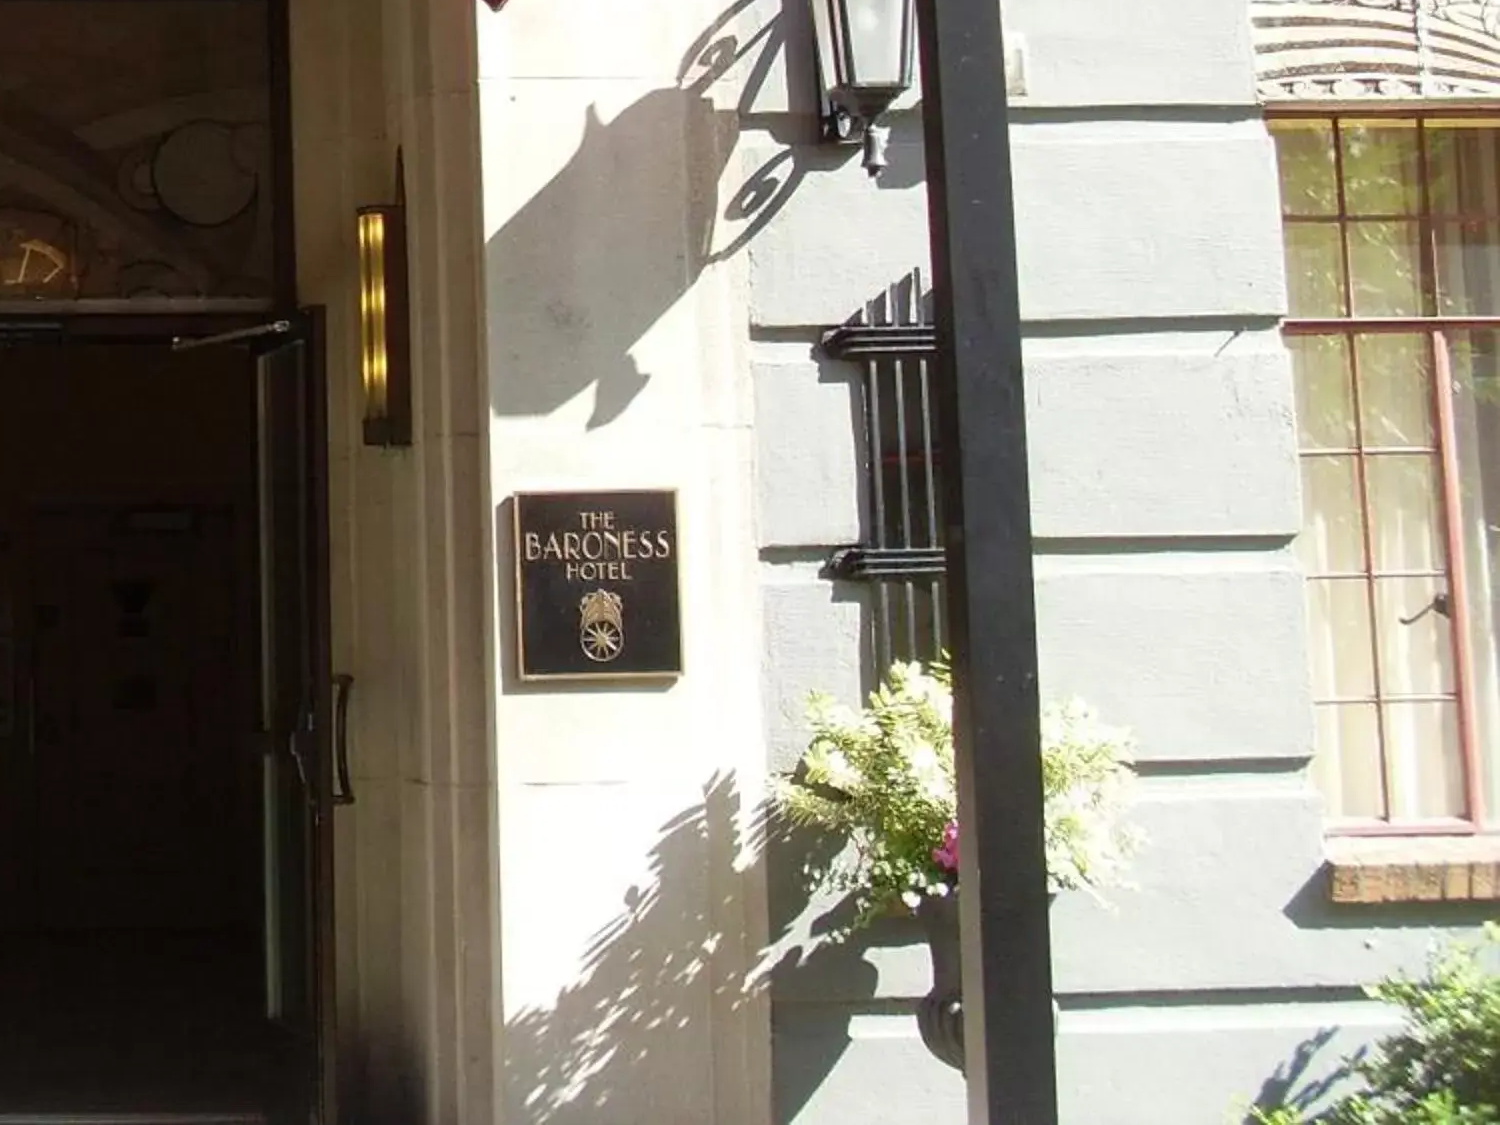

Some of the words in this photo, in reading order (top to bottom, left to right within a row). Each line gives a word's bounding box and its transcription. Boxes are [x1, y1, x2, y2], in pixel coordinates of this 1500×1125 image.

[579, 510, 615, 530] THE
[524, 530, 671, 561] BARONESS
[566, 561, 633, 581] HOTEL
